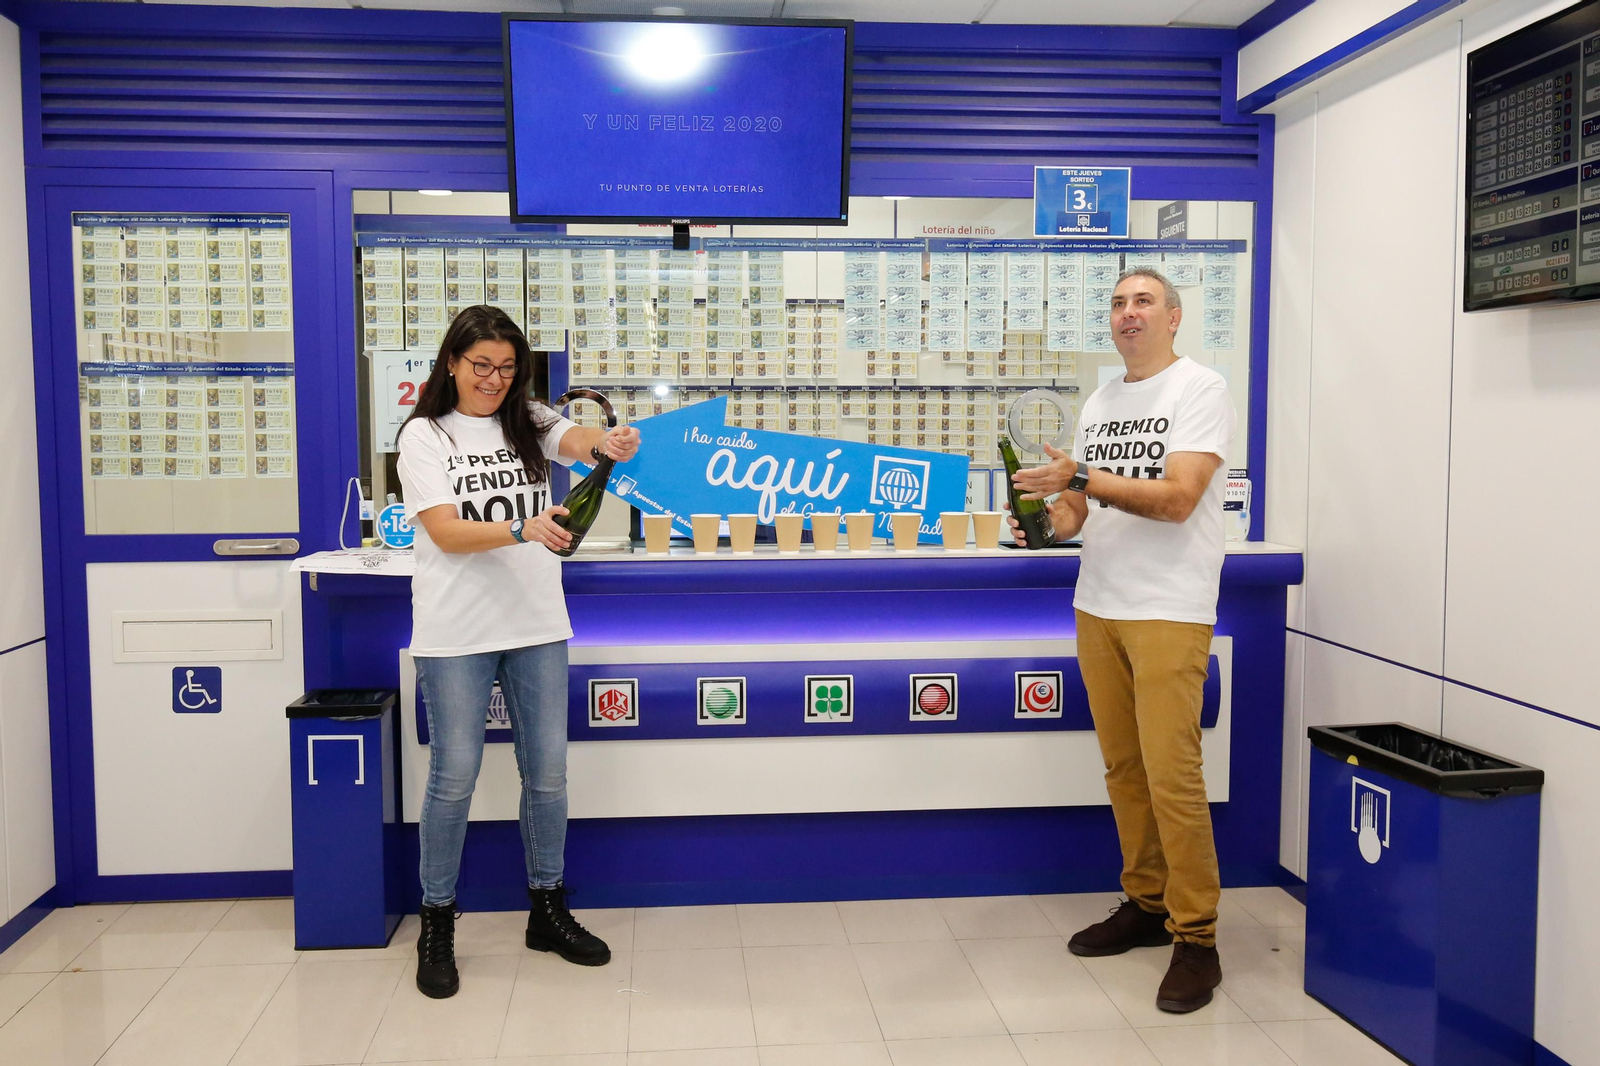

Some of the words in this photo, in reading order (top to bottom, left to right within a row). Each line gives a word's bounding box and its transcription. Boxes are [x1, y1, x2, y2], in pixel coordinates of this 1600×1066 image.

[583, 114, 598, 130] Y
[607, 114, 639, 130] UN
[649, 114, 715, 131] FELIZ
[723, 115, 783, 132] 2020
[1508, 170, 1514, 178] 11
[617, 184, 652, 192] PUNTO
[656, 184, 670, 192] DE
[674, 184, 709, 192] VENTA
[713, 184, 764, 193] LOTERÍAS
[922, 225, 955, 234] Lotería
[957, 225, 972, 234] del
[974, 226, 996, 235] niño
[1160, 220, 1185, 240] SIGUIENTE
[405, 359, 424, 372] 1er
[1096, 417, 1169, 438] PREMIO
[1083, 440, 1165, 462] ENDIDO
[706, 448, 850, 524] aquí
[632, 489, 664, 511] Apuestas
[664, 509, 676, 518] del
